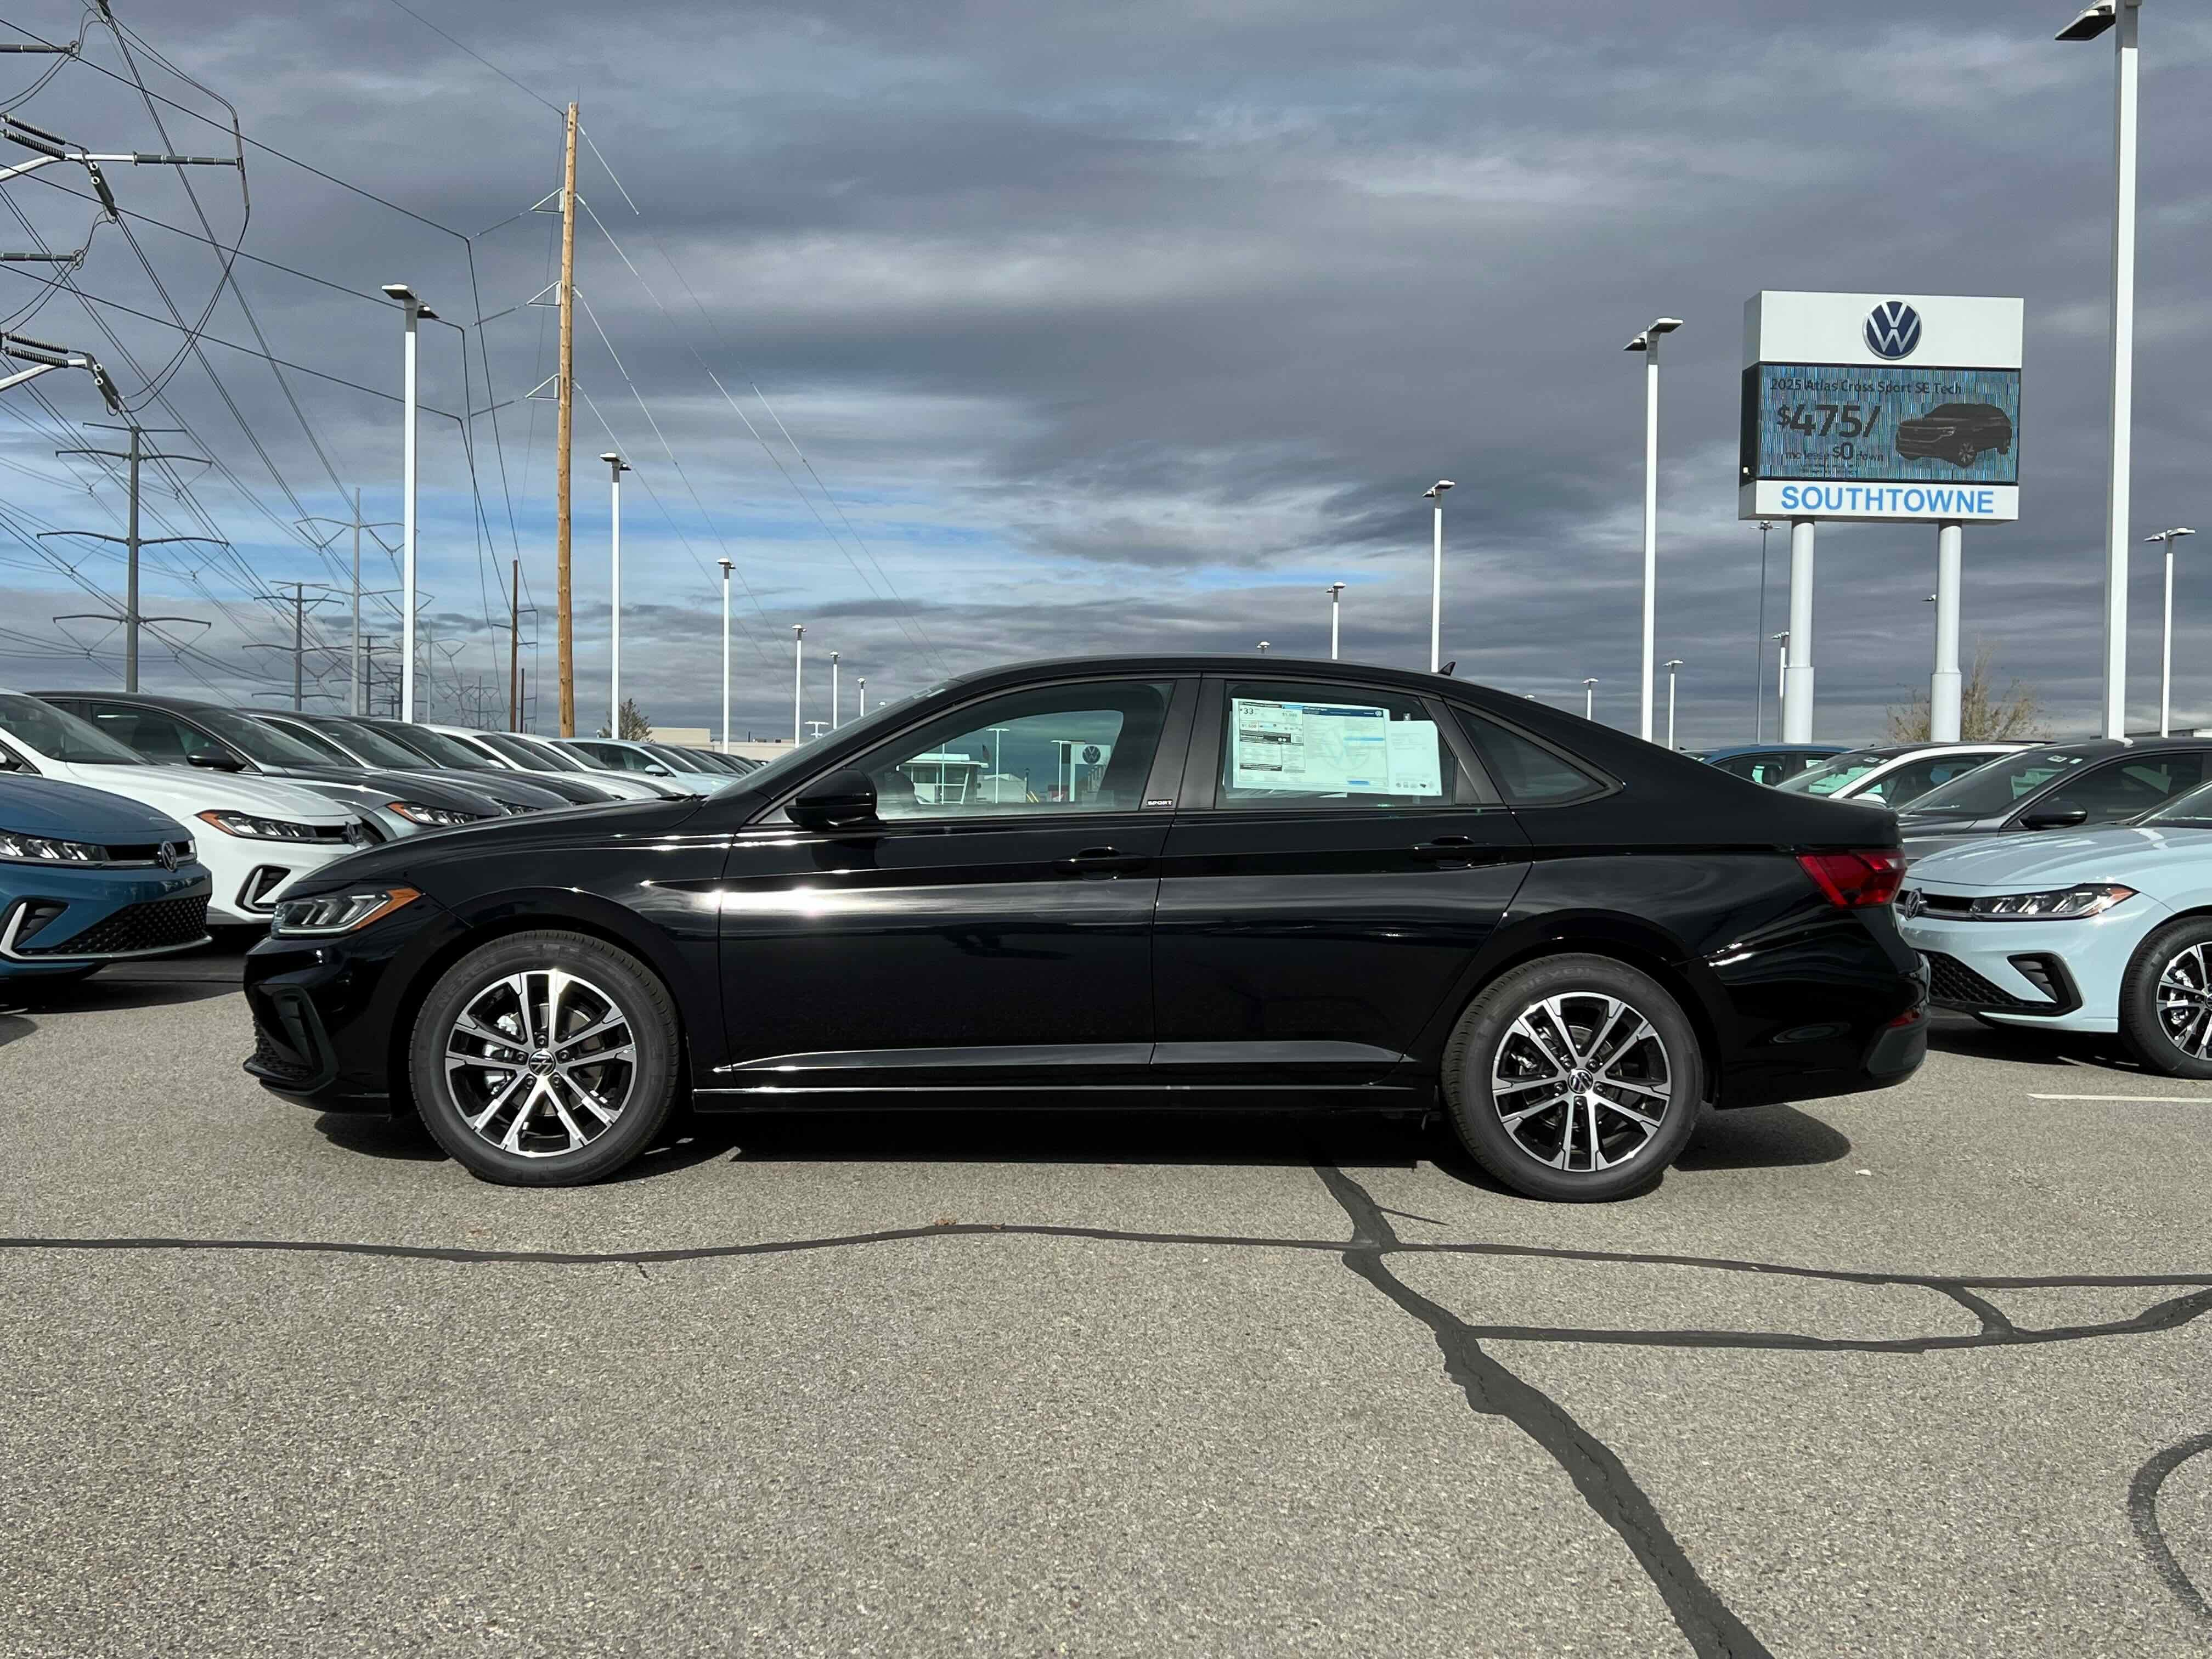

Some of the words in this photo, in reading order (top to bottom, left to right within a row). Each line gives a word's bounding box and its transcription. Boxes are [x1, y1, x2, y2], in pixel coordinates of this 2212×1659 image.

[1863, 299, 1921, 360] VW
[1770, 379, 1802, 391] 2025
[1804, 379, 1838, 391] Atlas
[1841, 380, 1875, 392] Cross
[1877, 381, 1911, 395] Sport
[1915, 382, 1929, 393] SE
[1934, 382, 1962, 394] Tech
[1781, 486, 1993, 514] SOUTHTOWNE
